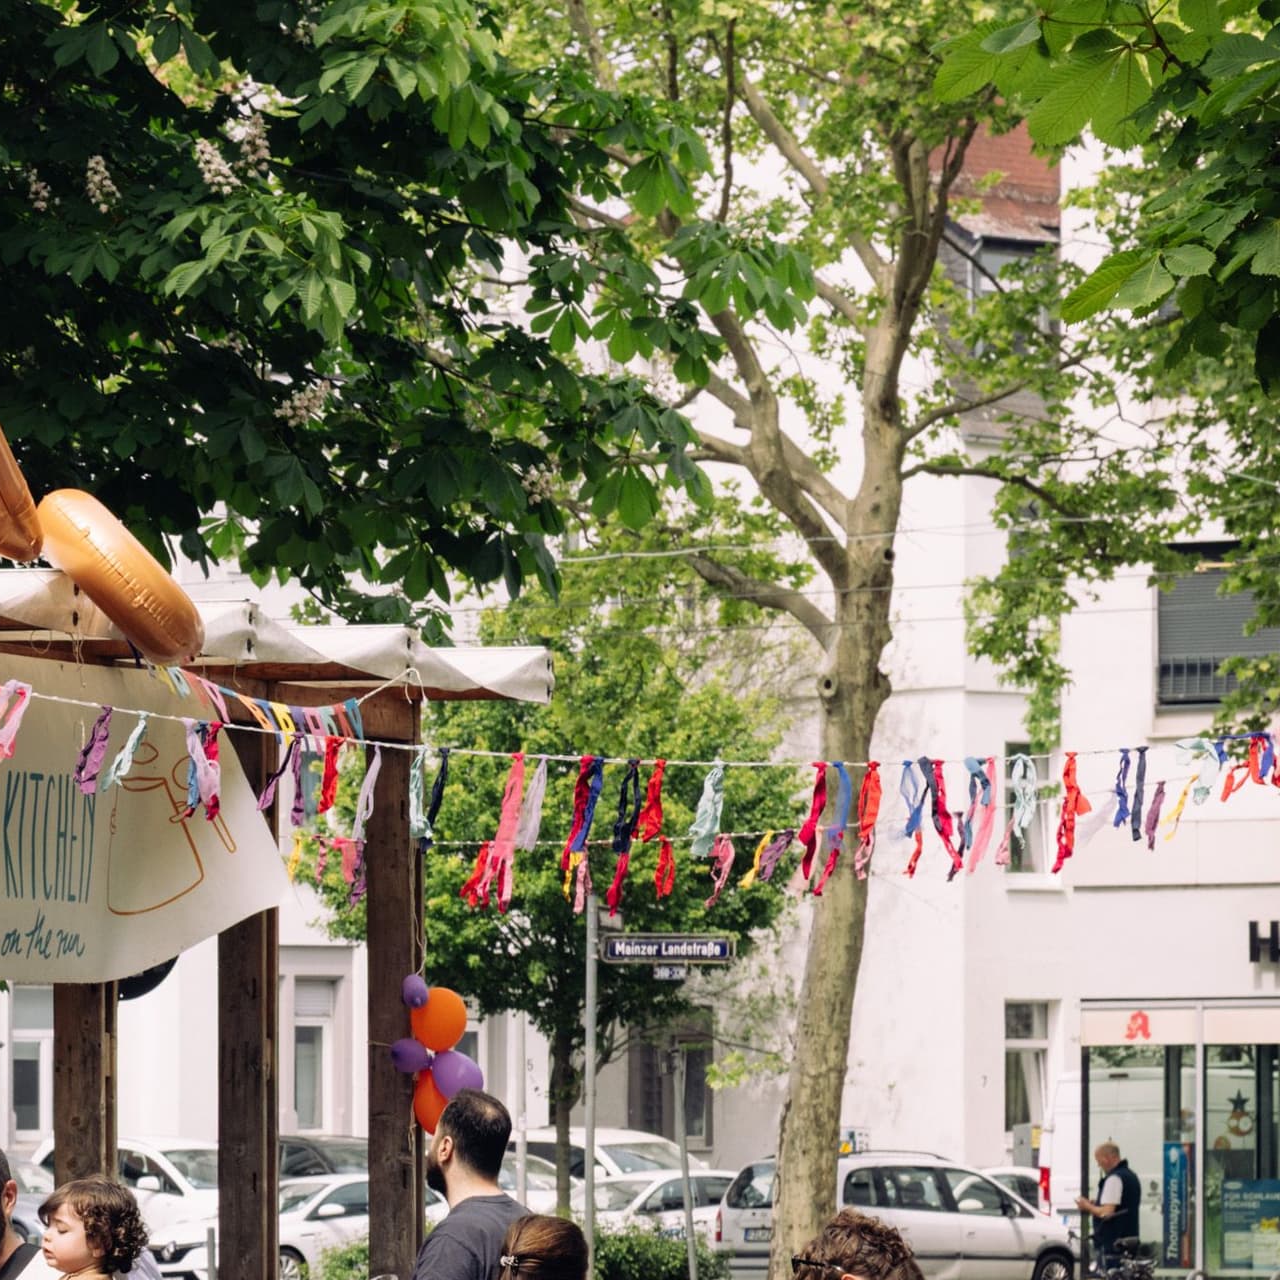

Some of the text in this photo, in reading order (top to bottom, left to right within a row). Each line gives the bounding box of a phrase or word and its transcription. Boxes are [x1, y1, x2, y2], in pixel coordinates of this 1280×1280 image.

[3, 769, 96, 904] KITCHEN
[0, 908, 85, 959] on the run
[615, 941, 721, 957] Mainzer Landstraße
[1167, 1179, 1181, 1260] Thomapyrin
